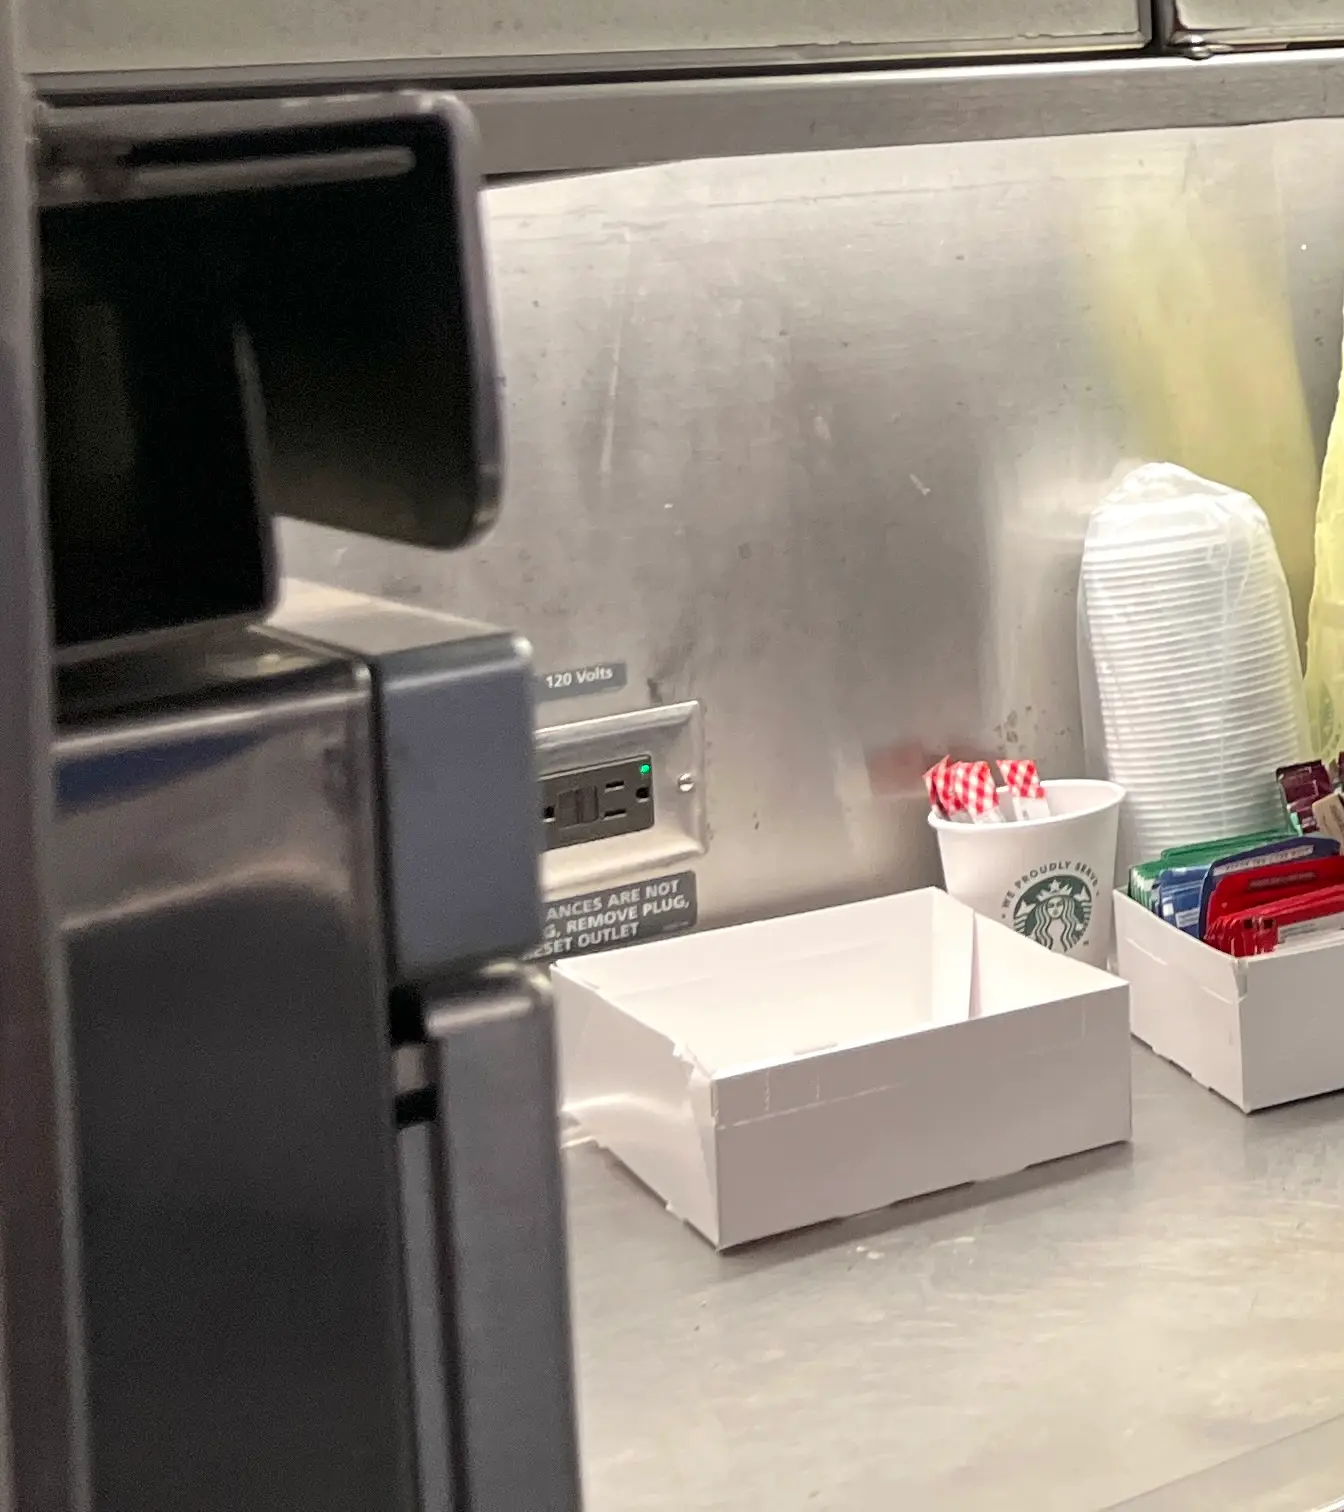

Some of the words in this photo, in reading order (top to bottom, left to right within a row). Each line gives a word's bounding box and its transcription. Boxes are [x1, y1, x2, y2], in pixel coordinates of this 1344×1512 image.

[546, 671, 573, 688] 120
[576, 664, 614, 684] Volts
[607, 888, 641, 906] ARE
[645, 879, 681, 898] NOT
[1001, 889, 1015, 909] WE
[1014, 860, 1072, 889] PROUDLY
[565, 905, 639, 935] REMOVE
[642, 894, 690, 917] PLUG,
[577, 921, 640, 948] OUTLET
